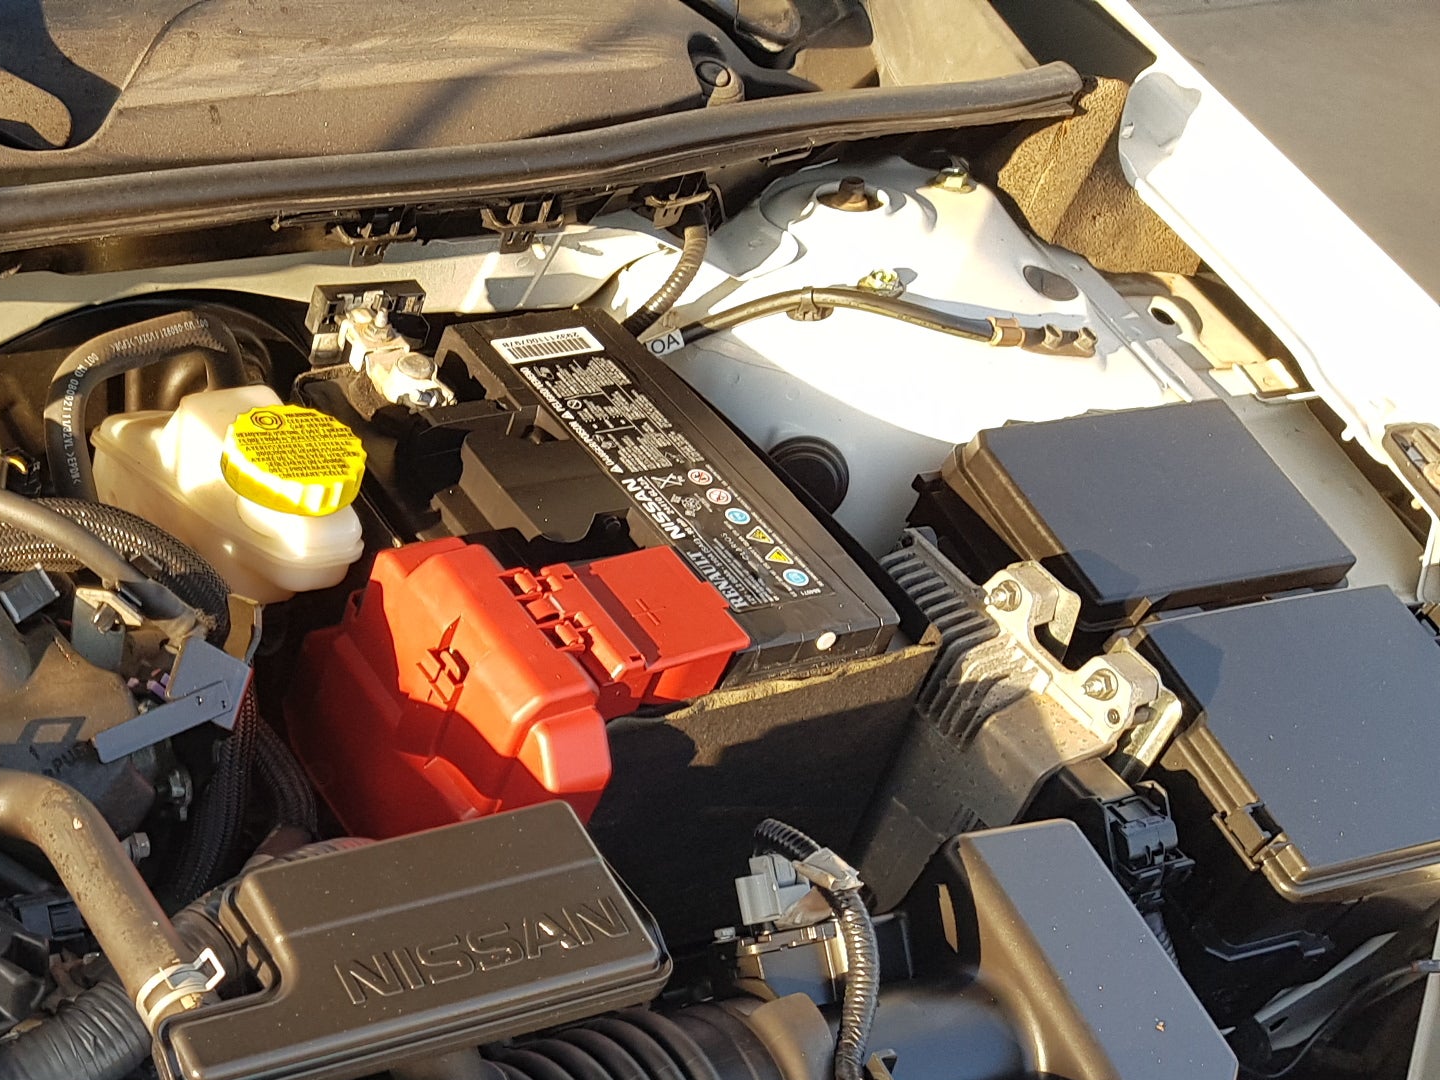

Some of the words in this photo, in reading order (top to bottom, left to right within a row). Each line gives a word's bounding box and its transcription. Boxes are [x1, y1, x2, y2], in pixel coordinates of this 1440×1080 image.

[619, 477, 687, 539] NISSAN
[685, 549, 750, 608] RENAULT
[333, 896, 630, 1005] NISSAN
